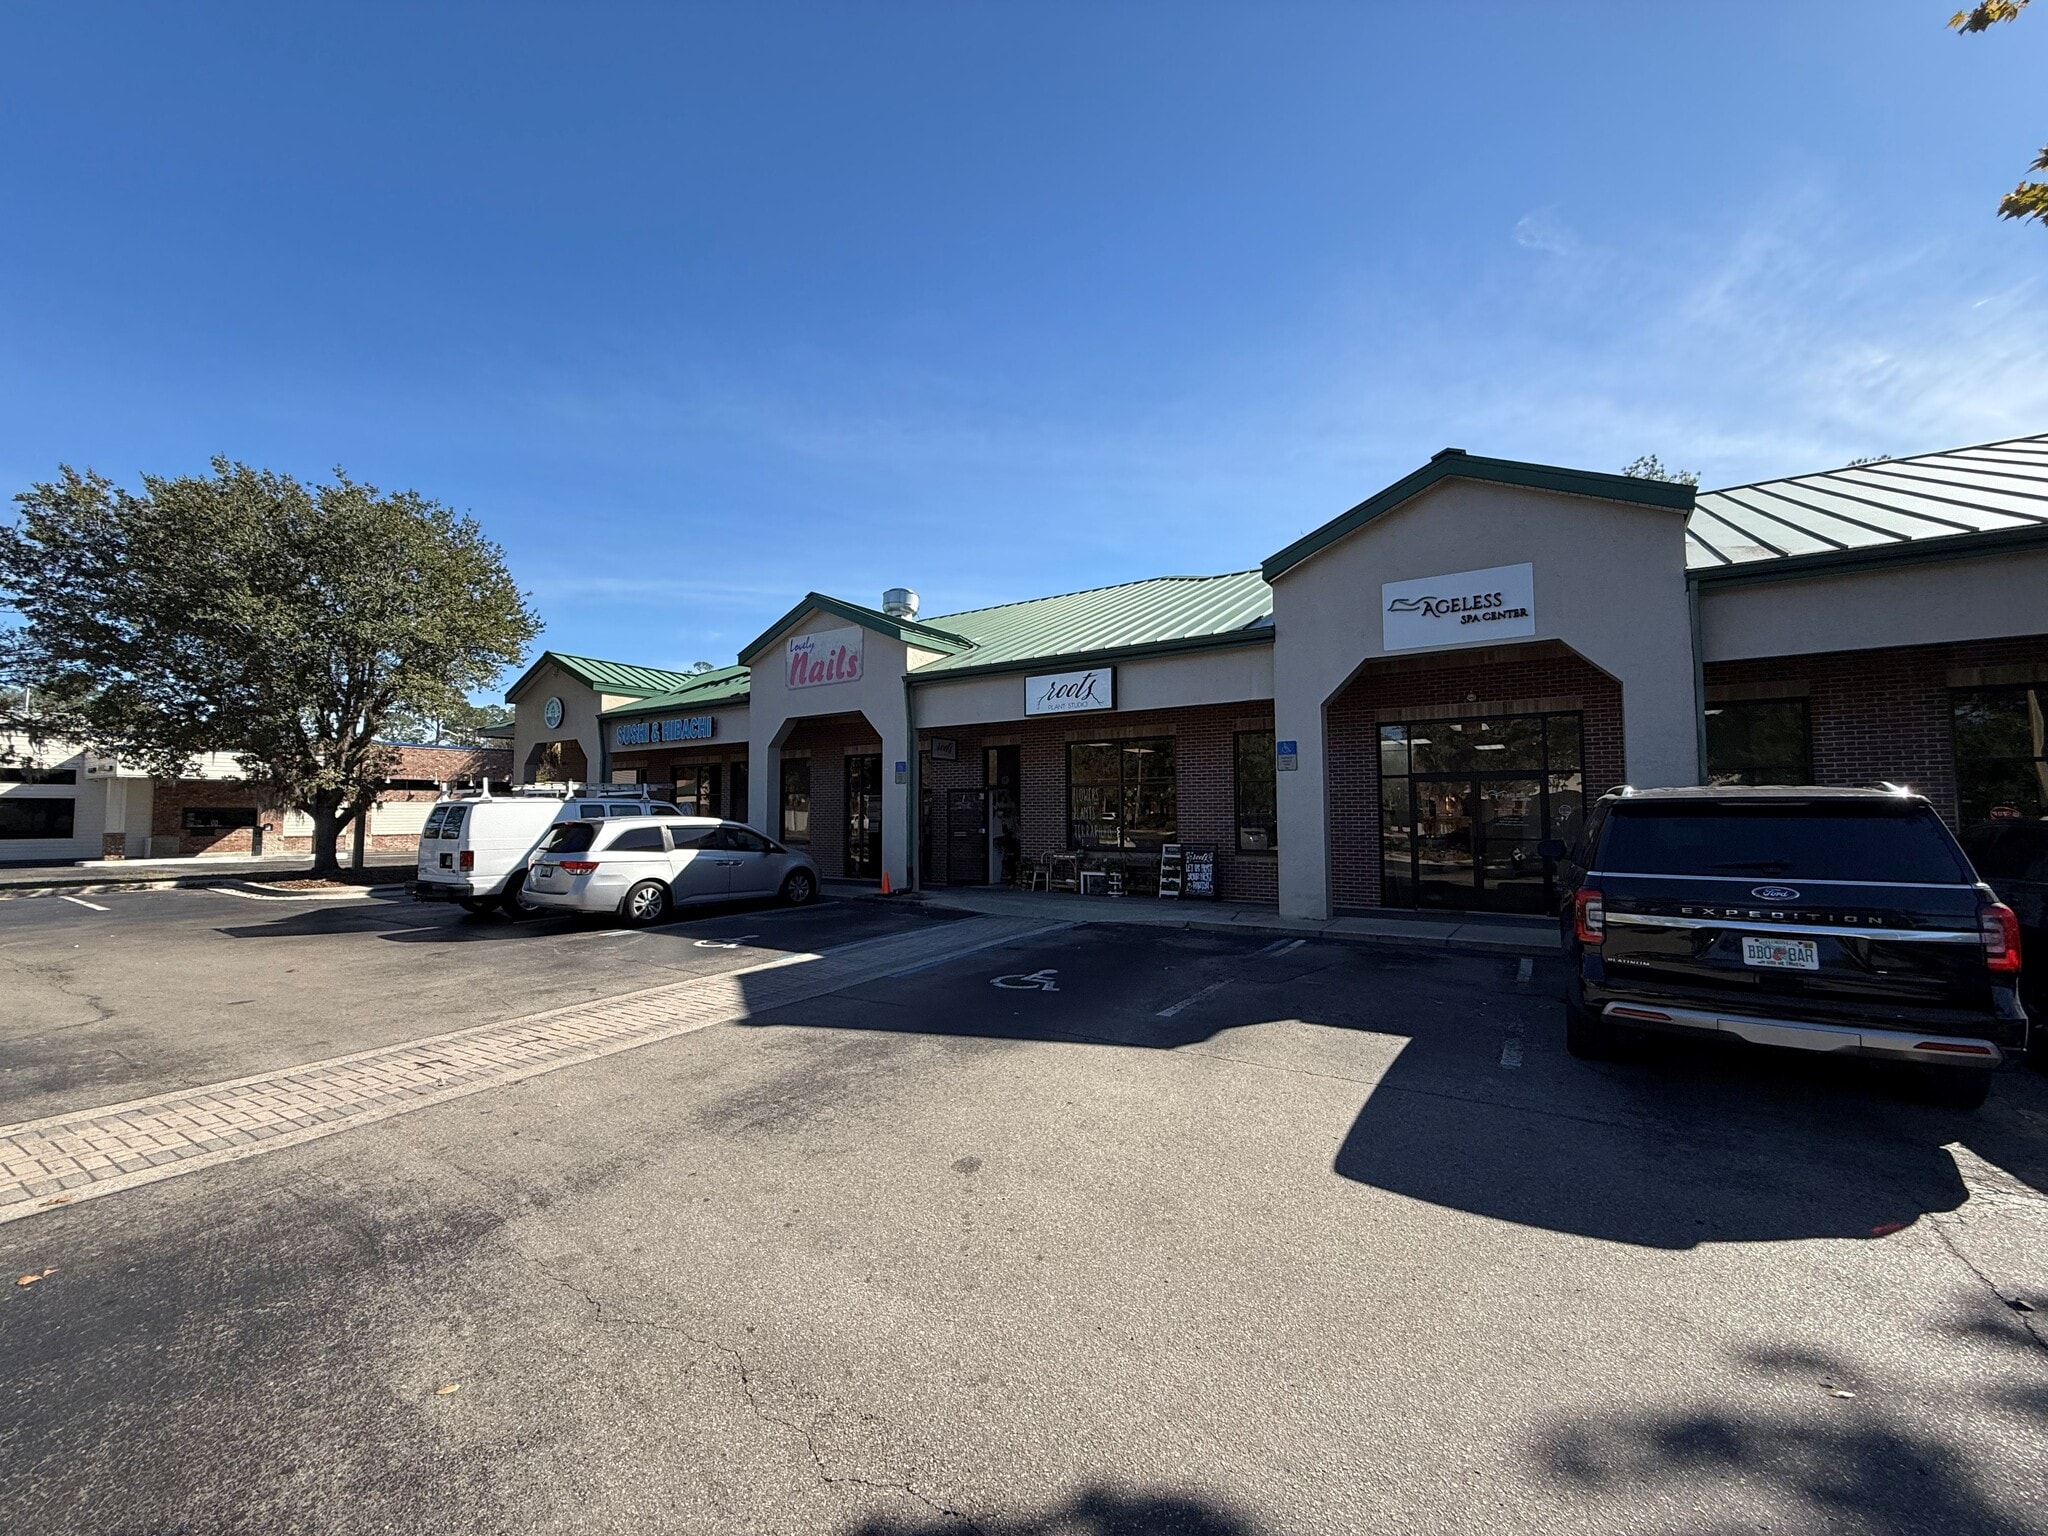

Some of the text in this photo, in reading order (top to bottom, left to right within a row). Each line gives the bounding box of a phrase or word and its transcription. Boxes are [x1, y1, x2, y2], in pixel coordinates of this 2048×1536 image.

[1421, 592, 1503, 618] AGELESS
[1460, 608, 1528, 625] SPA CENTER
[790, 636, 815, 653] Lovely
[789, 645, 858, 686] Nails
[1041, 672, 1100, 703] roots
[1047, 701, 1089, 711] PLANT STUDIO
[616, 716, 713, 746] SUSHI & HIBACHI
[1762, 888, 1790, 898] Ford
[1681, 907, 1883, 924] EXPEDITION
